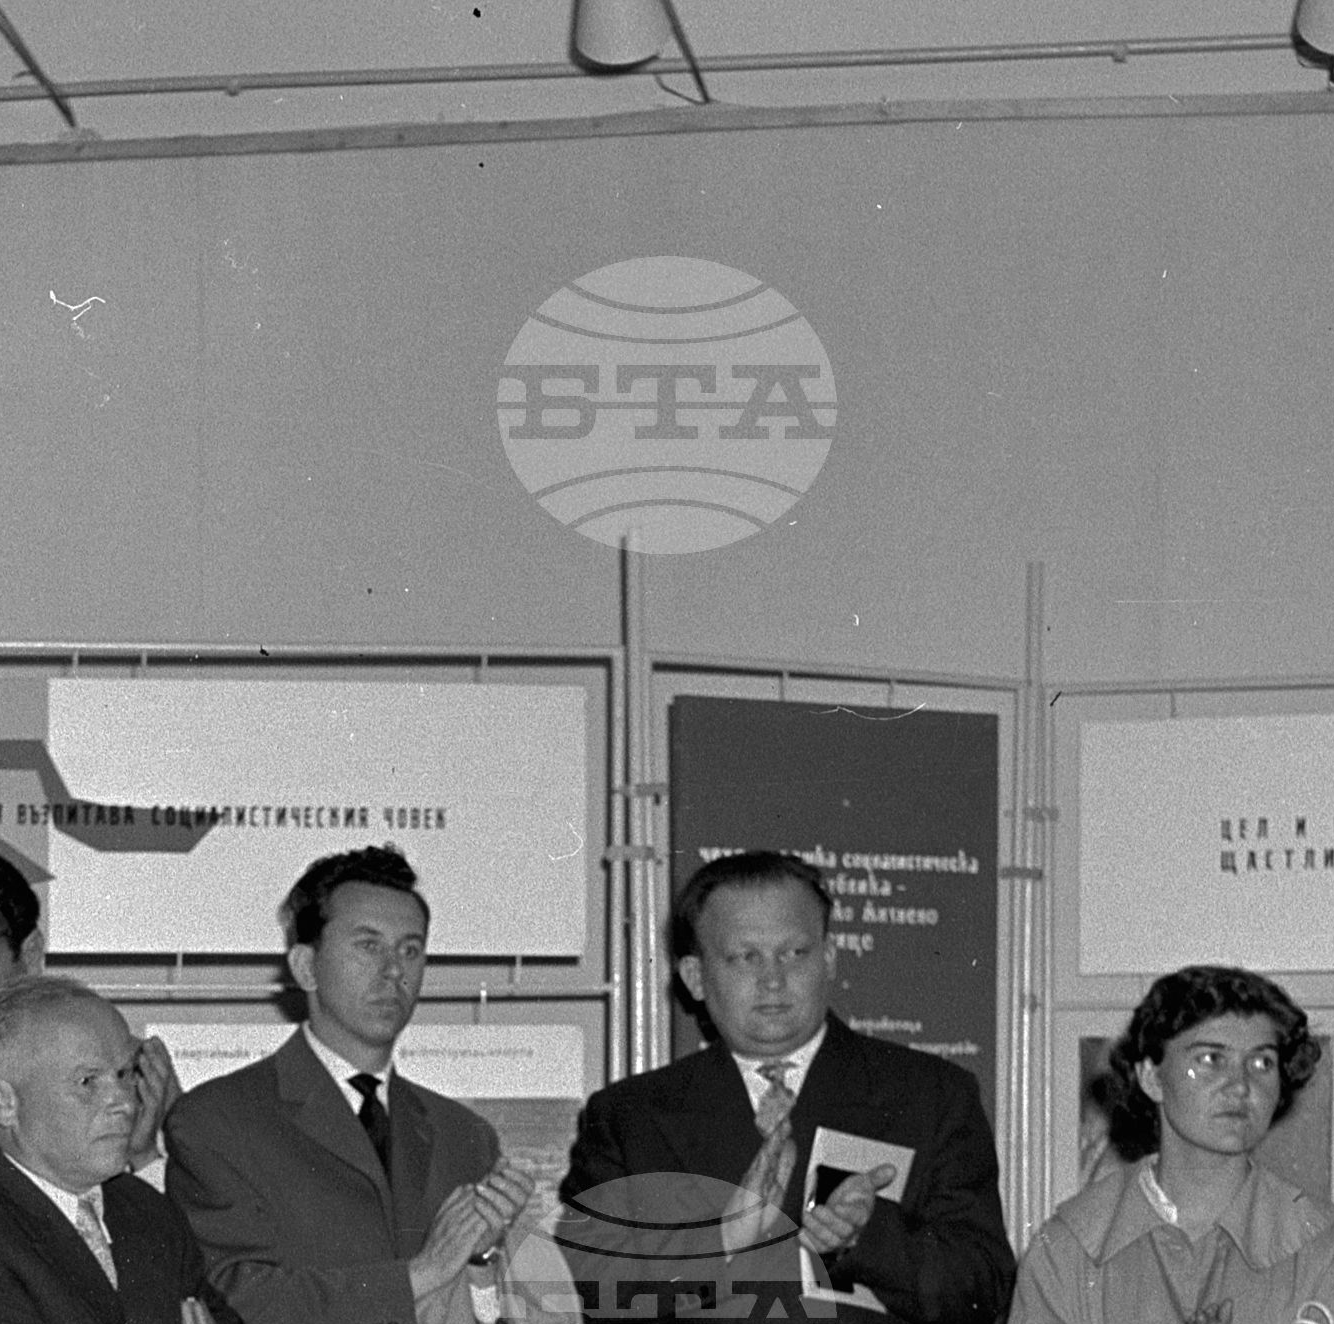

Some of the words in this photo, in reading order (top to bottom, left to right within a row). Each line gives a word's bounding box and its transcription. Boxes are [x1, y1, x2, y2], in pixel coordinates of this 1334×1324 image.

[17, 803, 135, 826] ВЪЗПИТАВА
[151, 805, 369, 829] СОЦИАЛИСТИЧЕСКИЯ
[383, 806, 446, 829] ЧОВЕК
[1220, 817, 1268, 841] ЦЕЛ
[1295, 816, 1307, 838] И
